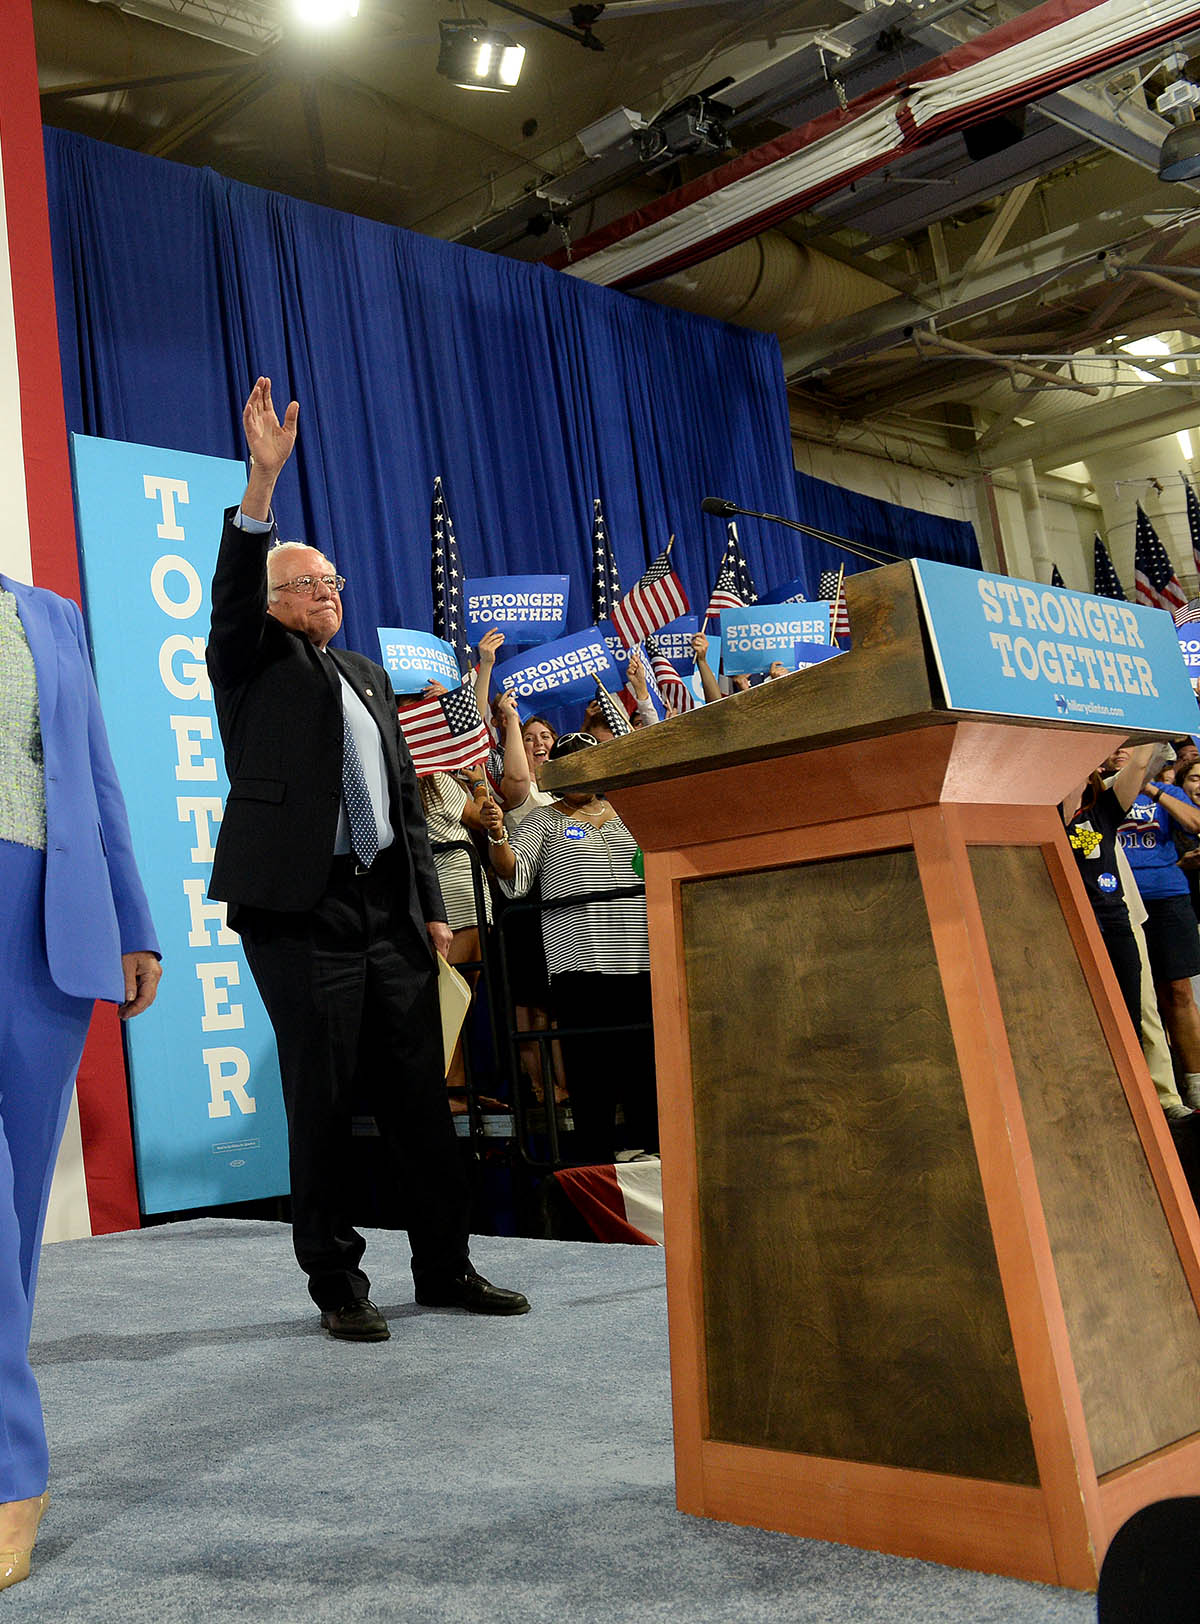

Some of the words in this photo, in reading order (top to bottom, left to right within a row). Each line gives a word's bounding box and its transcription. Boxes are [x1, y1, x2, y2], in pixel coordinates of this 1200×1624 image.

[468, 593, 564, 609] STRONGER
[977, 577, 1145, 649] STRONGER
[469, 607, 563, 624] TOGETHER
[726, 620, 825, 639] STRONGER
[386, 644, 458, 669] STRONGER
[502, 643, 605, 690] STRONGER
[989, 631, 1160, 698] TOGETHER
[387, 657, 460, 681] TOGETHER
[143, 474, 257, 1119] TOGETHER
[1116, 831, 1157, 849] 016
